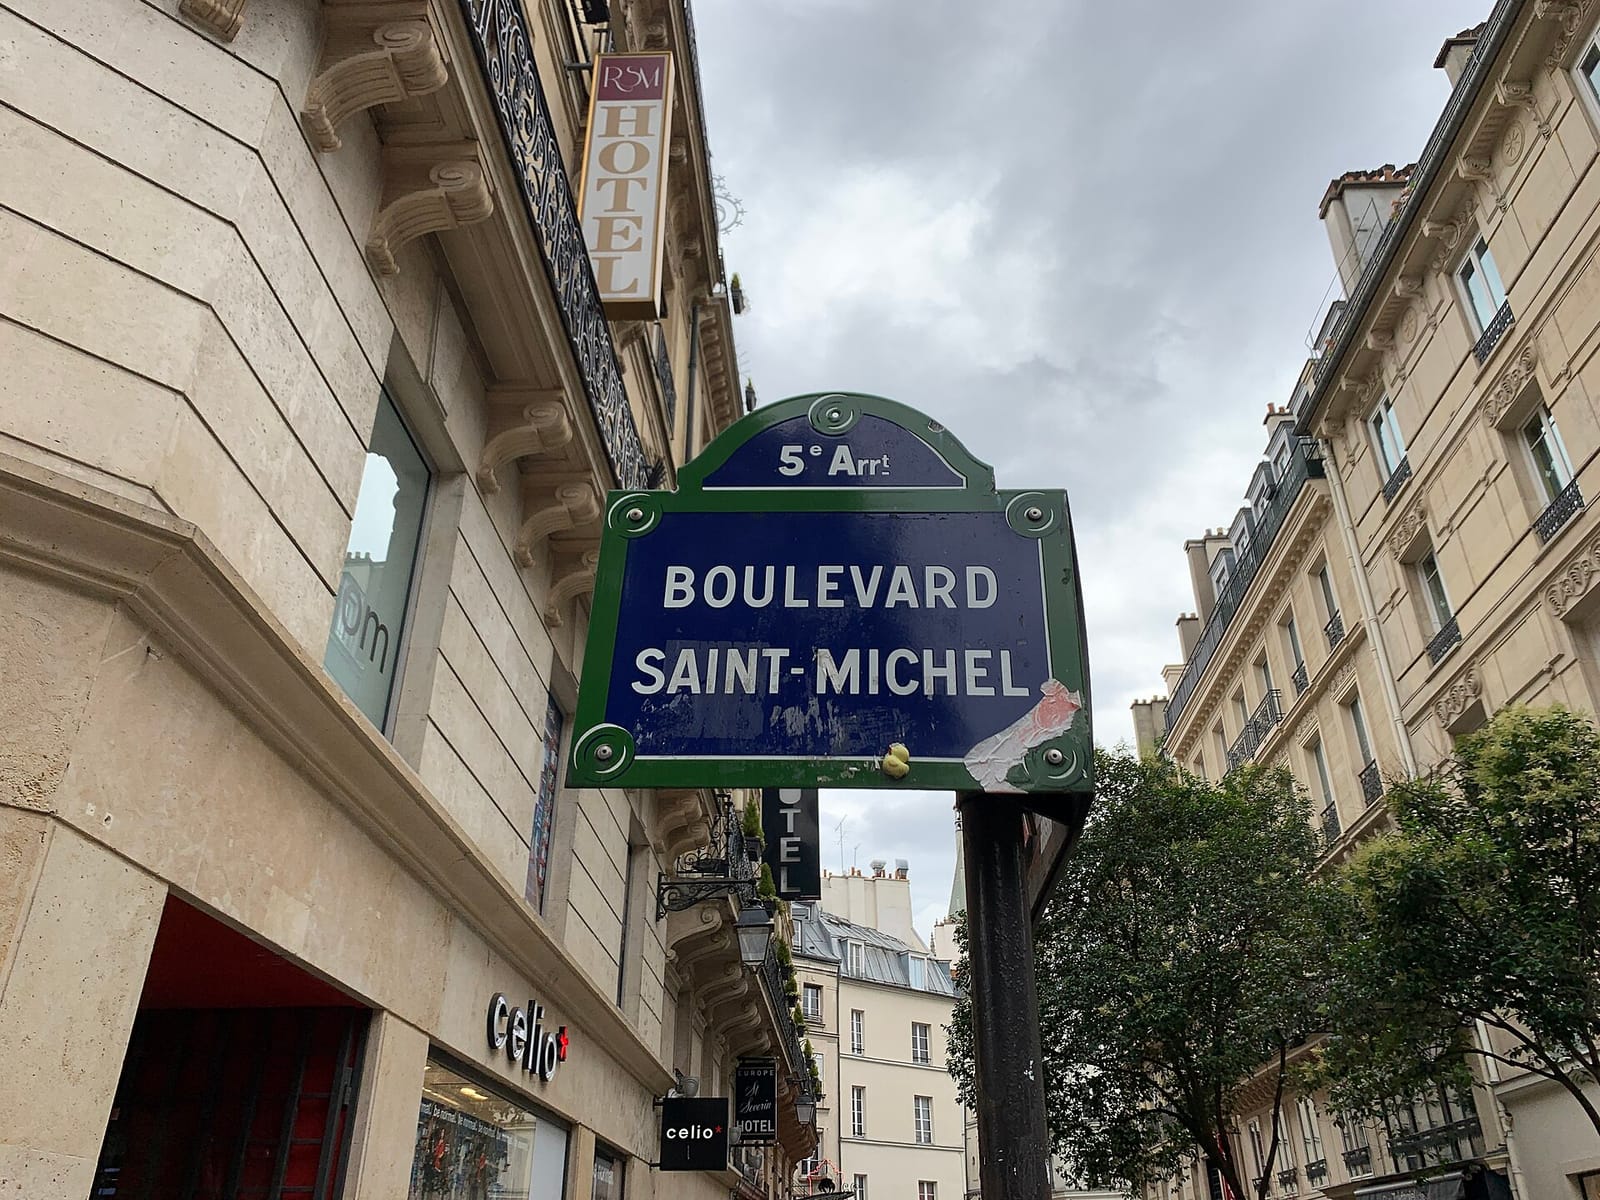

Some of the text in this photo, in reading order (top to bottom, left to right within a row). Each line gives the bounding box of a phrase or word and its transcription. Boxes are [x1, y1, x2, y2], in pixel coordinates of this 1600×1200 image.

[603, 65, 660, 93] RSM
[590, 104, 657, 295] HOTEL
[663, 565, 998, 610] BOULEVARD
[631, 647, 1030, 698] SAINT-MICHEL
[736, 1119, 775, 1132] HOTEL
